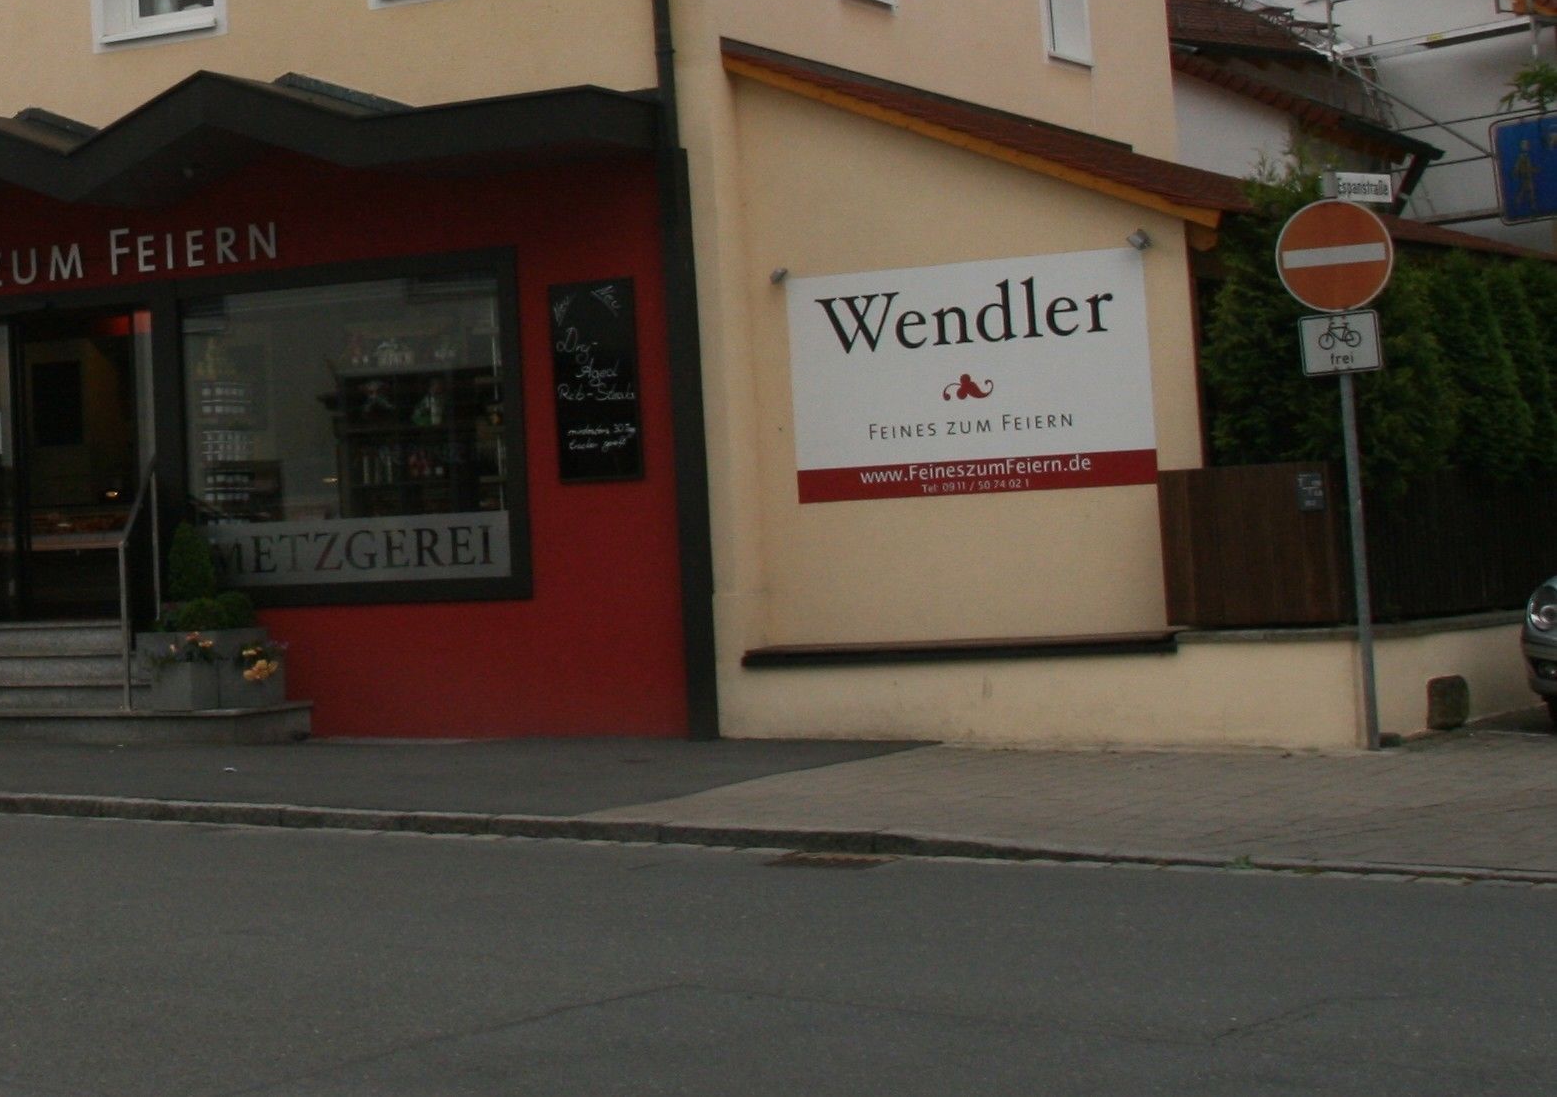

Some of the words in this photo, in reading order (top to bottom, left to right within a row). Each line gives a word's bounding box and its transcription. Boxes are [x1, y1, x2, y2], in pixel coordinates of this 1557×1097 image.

[108, 221, 278, 276] FEIERN
[814, 276, 1114, 355] Wendler
[1330, 352, 1354, 366] frei
[868, 422, 938, 441] FEINES
[1001, 413, 1074, 432] FEIERN
[859, 454, 1092, 484] www.FeineszumFeiern.de
[212, 524, 495, 575] METZGEREI
